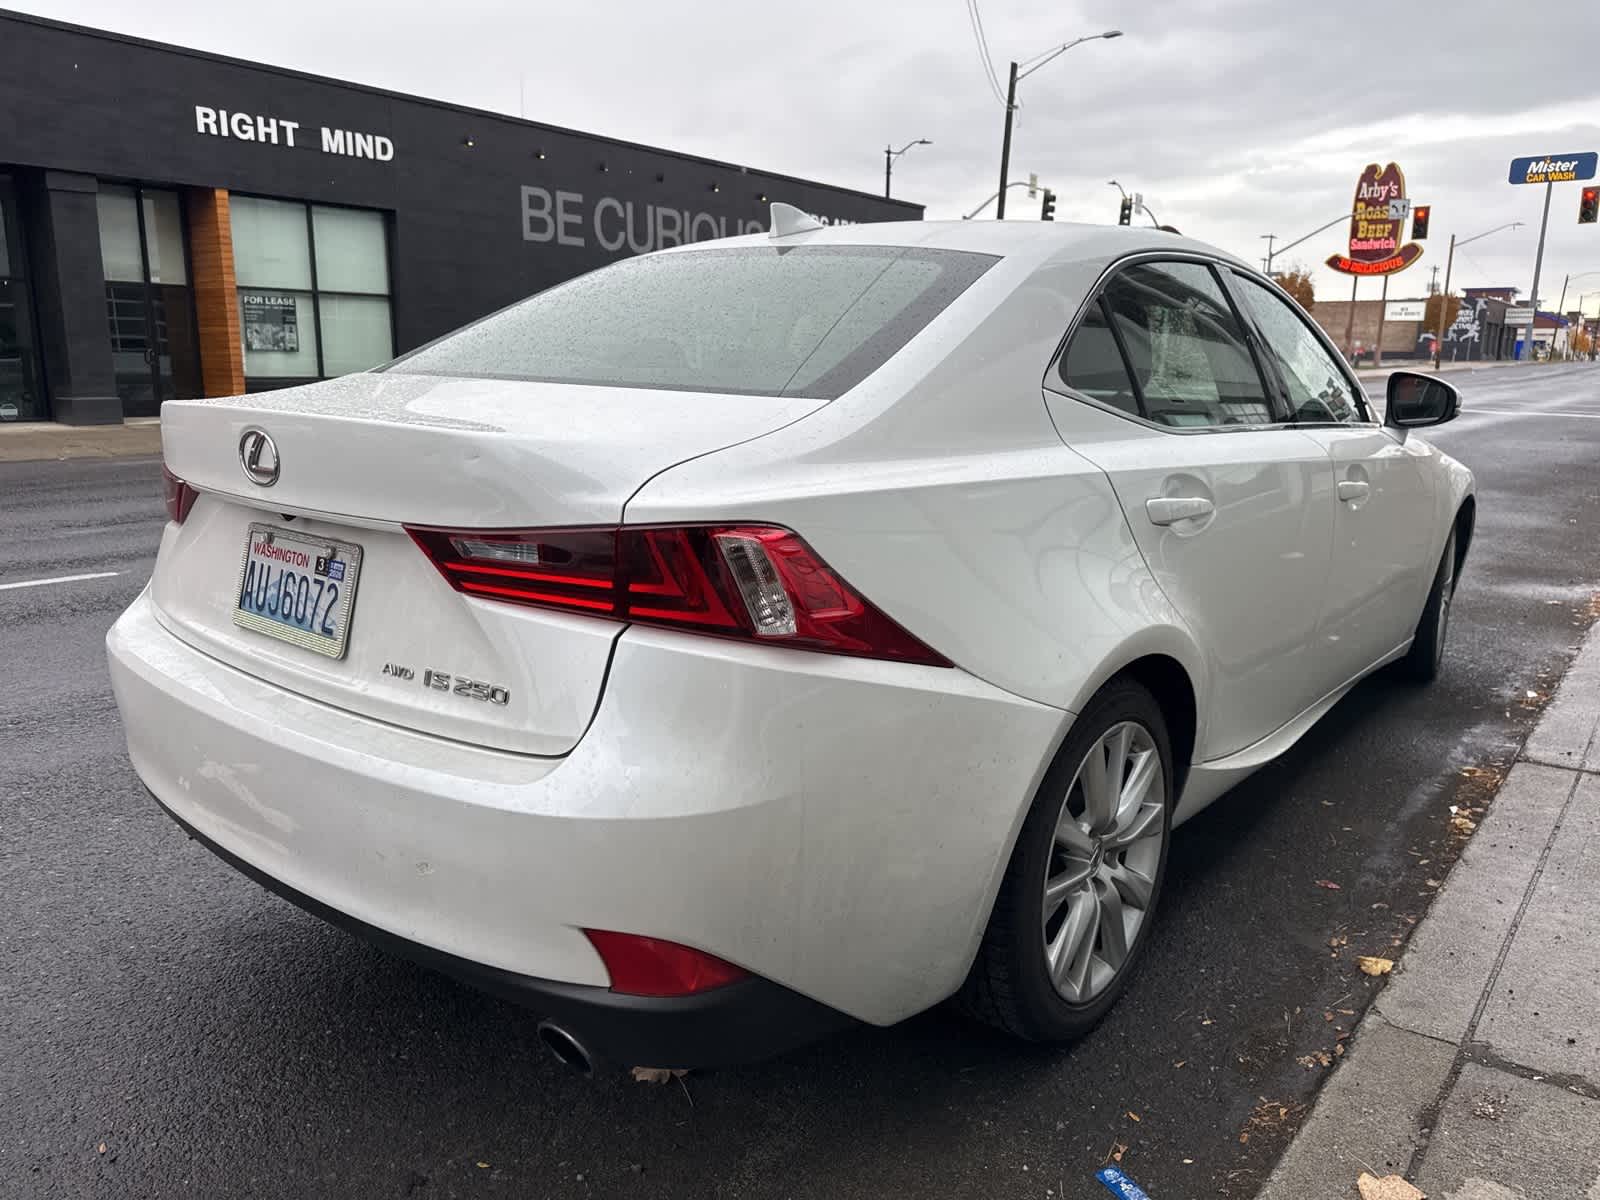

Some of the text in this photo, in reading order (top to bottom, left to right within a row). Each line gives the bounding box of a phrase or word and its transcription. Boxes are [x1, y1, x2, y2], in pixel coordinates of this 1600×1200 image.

[195, 105, 394, 162] RIGHT MIND
[1527, 160, 1578, 174] Mister
[1526, 171, 1576, 182] CAR WASH
[1359, 181, 1399, 201] Arby's
[520, 185, 585, 247] BE
[1355, 202, 1389, 219] ROAS
[1351, 238, 1395, 250] Sandwich
[1350, 256, 1403, 272] DELICIOUS
[244, 296, 295, 305] FOR LEASE
[254, 541, 310, 568] WASHINGTON
[319, 558, 325, 571] 3
[242, 560, 339, 636] AUJ6072
[382, 664, 510, 706] AWD IS 250
